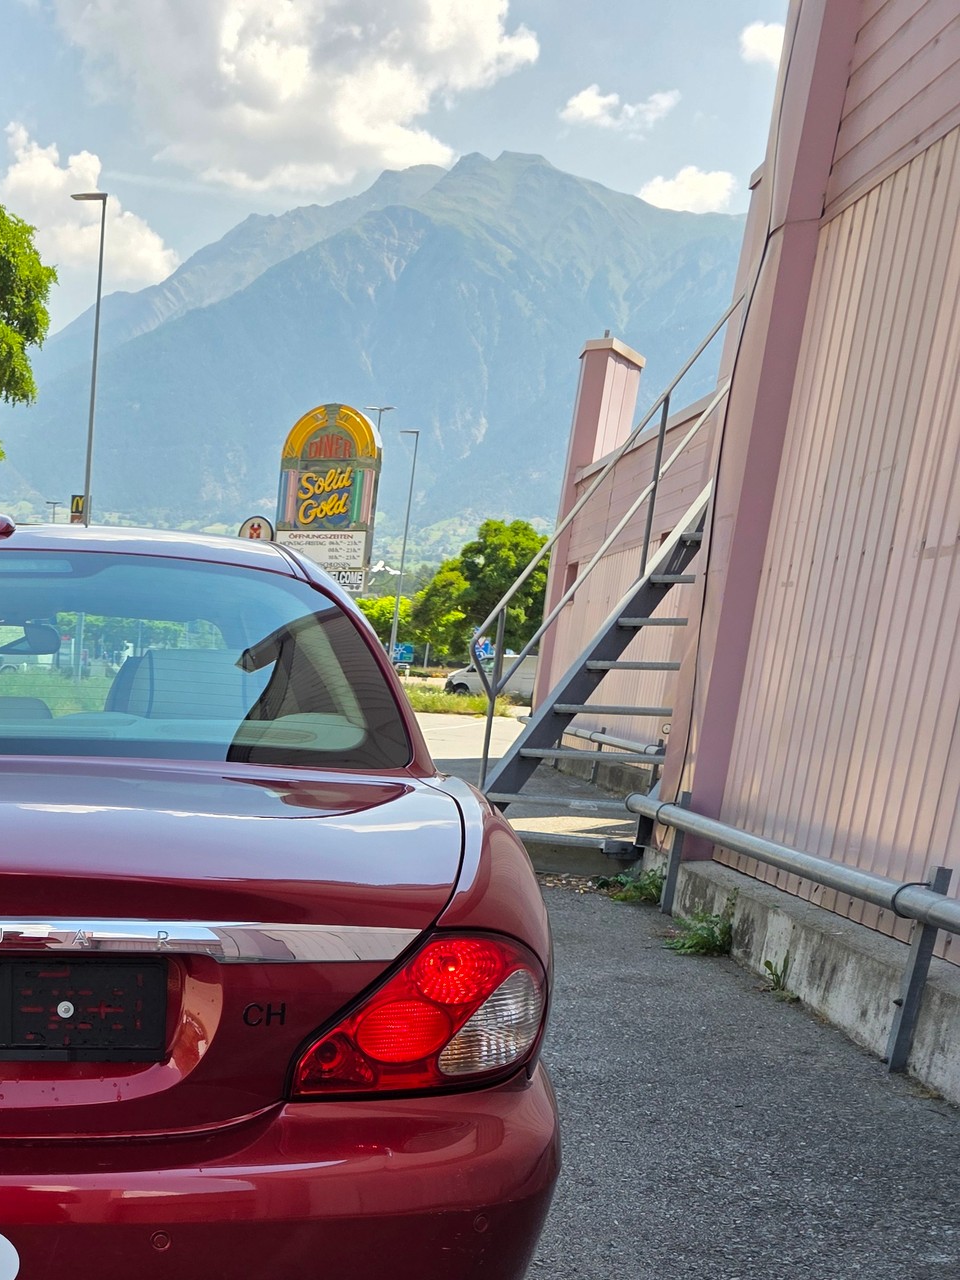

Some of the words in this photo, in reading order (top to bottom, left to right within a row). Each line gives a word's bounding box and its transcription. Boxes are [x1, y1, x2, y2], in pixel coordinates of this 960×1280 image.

[308, 433, 352, 458] DINER
[298, 467, 353, 500] Solid
[298, 493, 349, 525] Gold
[242, 1001, 287, 1028] CH
